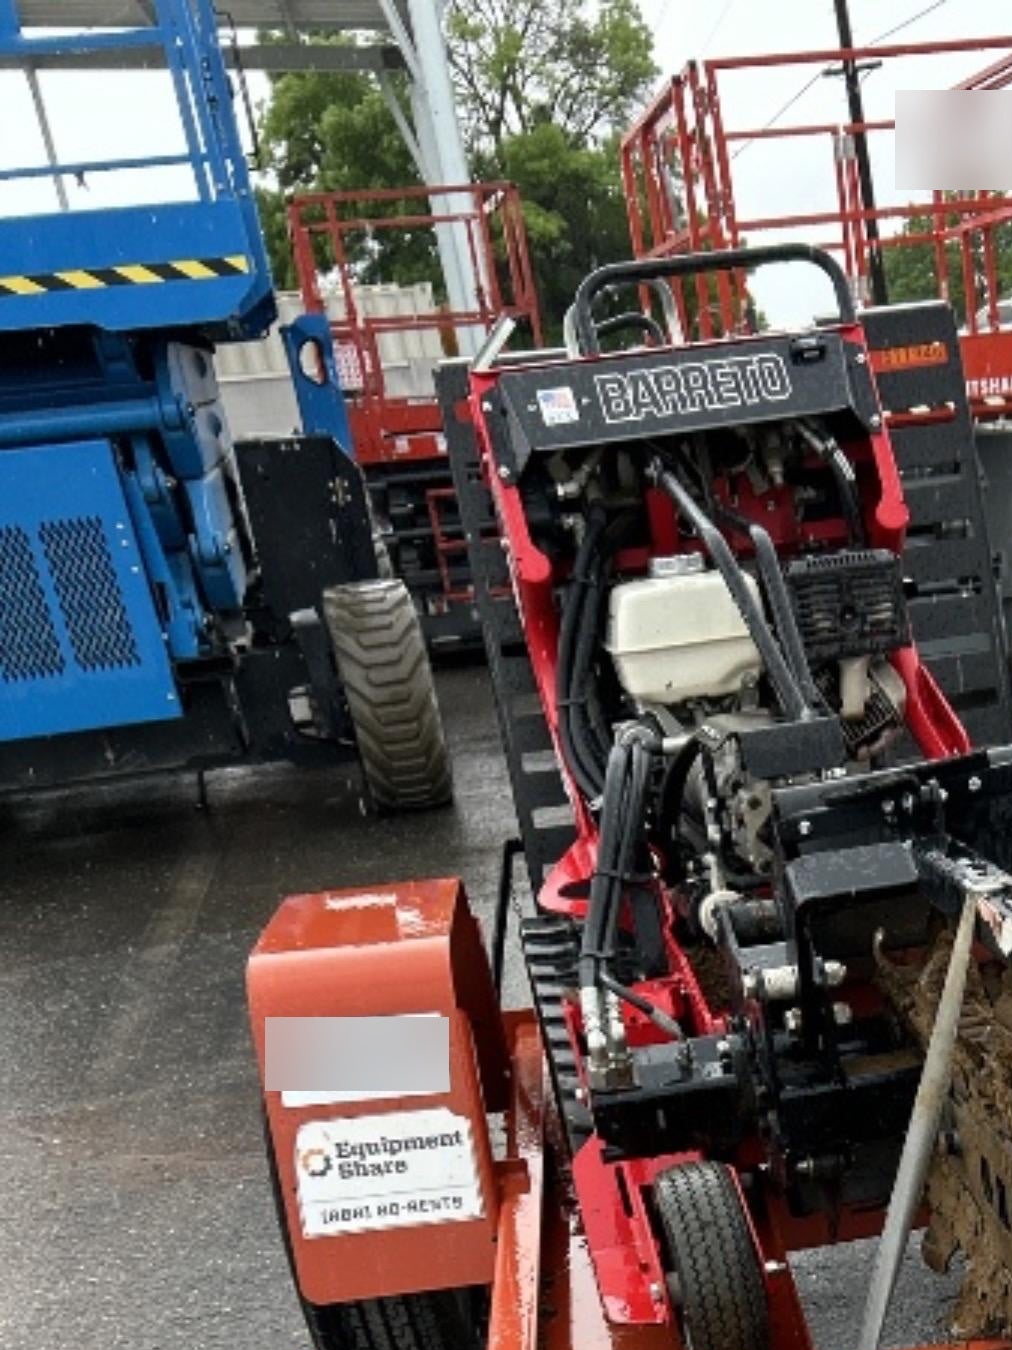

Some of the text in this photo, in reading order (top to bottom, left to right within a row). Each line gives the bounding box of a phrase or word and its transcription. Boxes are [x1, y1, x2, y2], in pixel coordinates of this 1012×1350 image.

[593, 353, 793, 423] BARRETO
[333, 1130, 463, 1162] Equipment
[337, 1159, 409, 1180] Share
